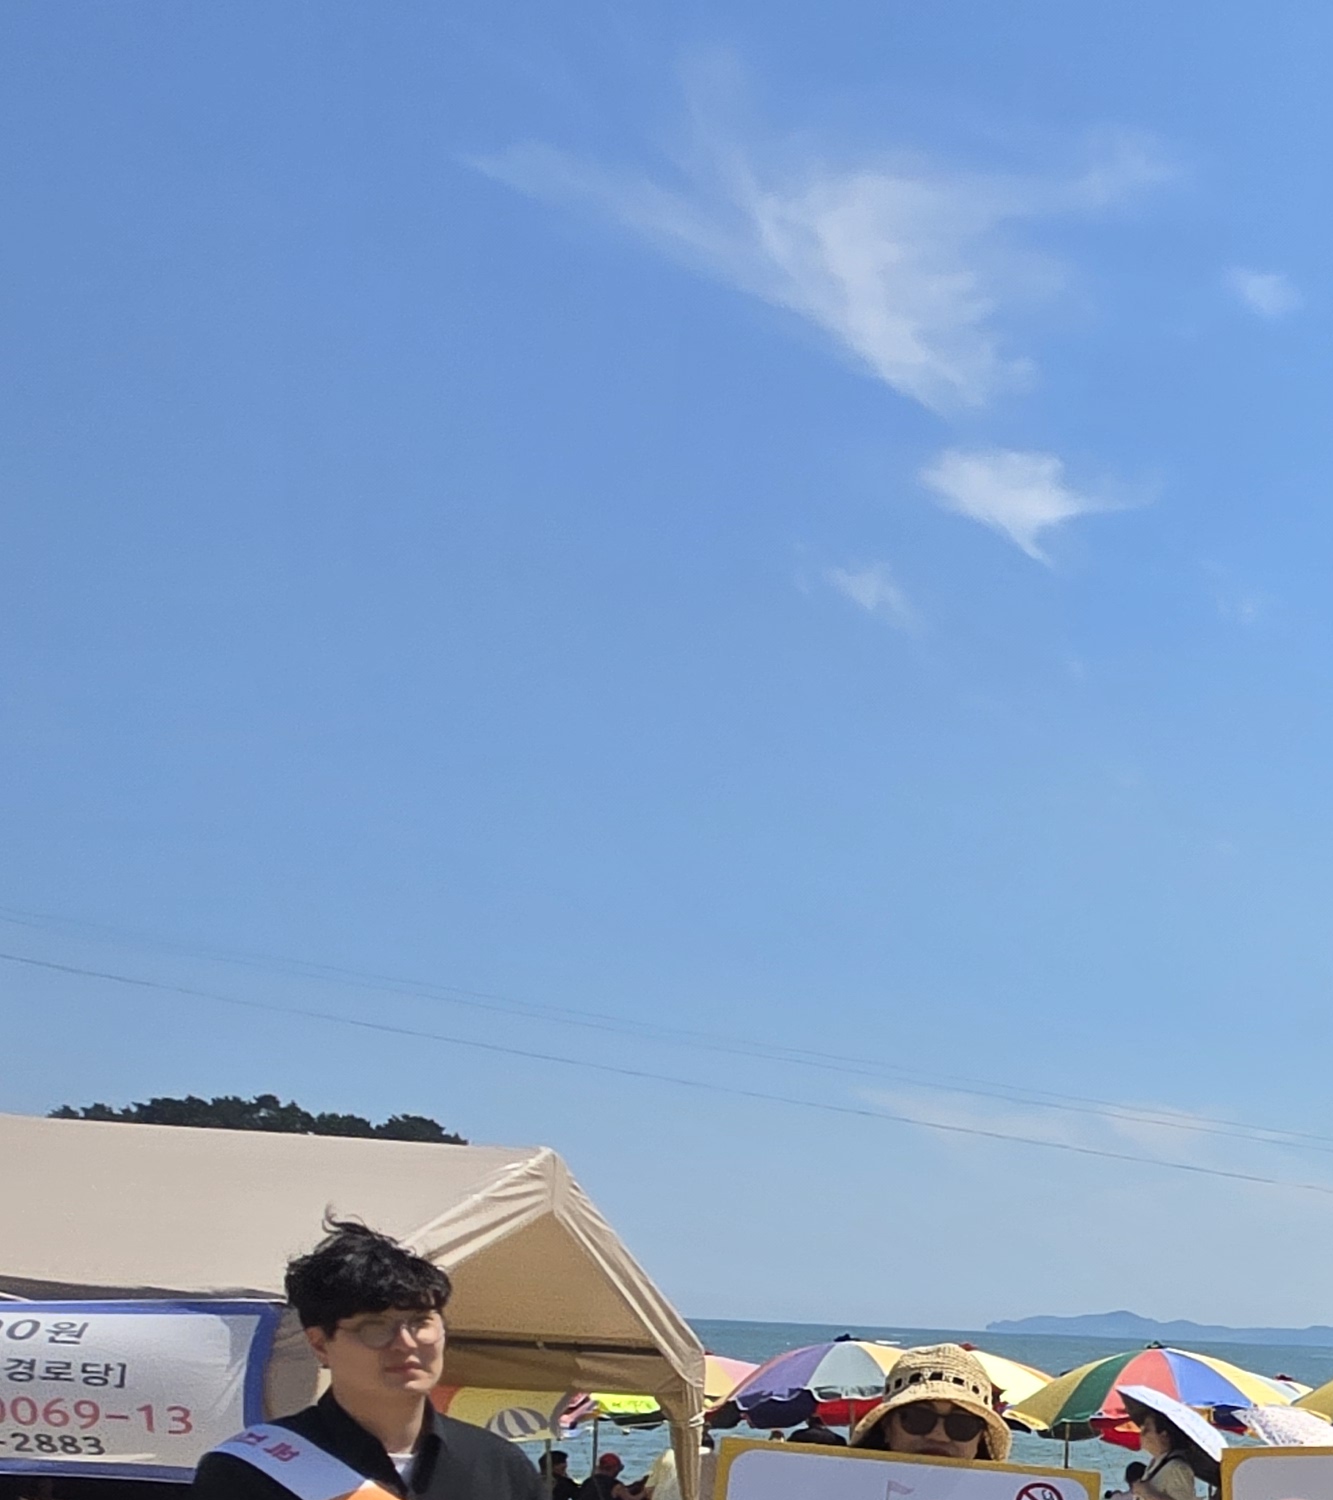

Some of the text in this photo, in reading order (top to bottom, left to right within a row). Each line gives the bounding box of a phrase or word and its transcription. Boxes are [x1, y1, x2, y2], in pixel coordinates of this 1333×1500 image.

[0, 1319, 89, 1345] 0원
[4, 1357, 127, 1388] 경로당]
[0, 1396, 193, 1434] 069-13
